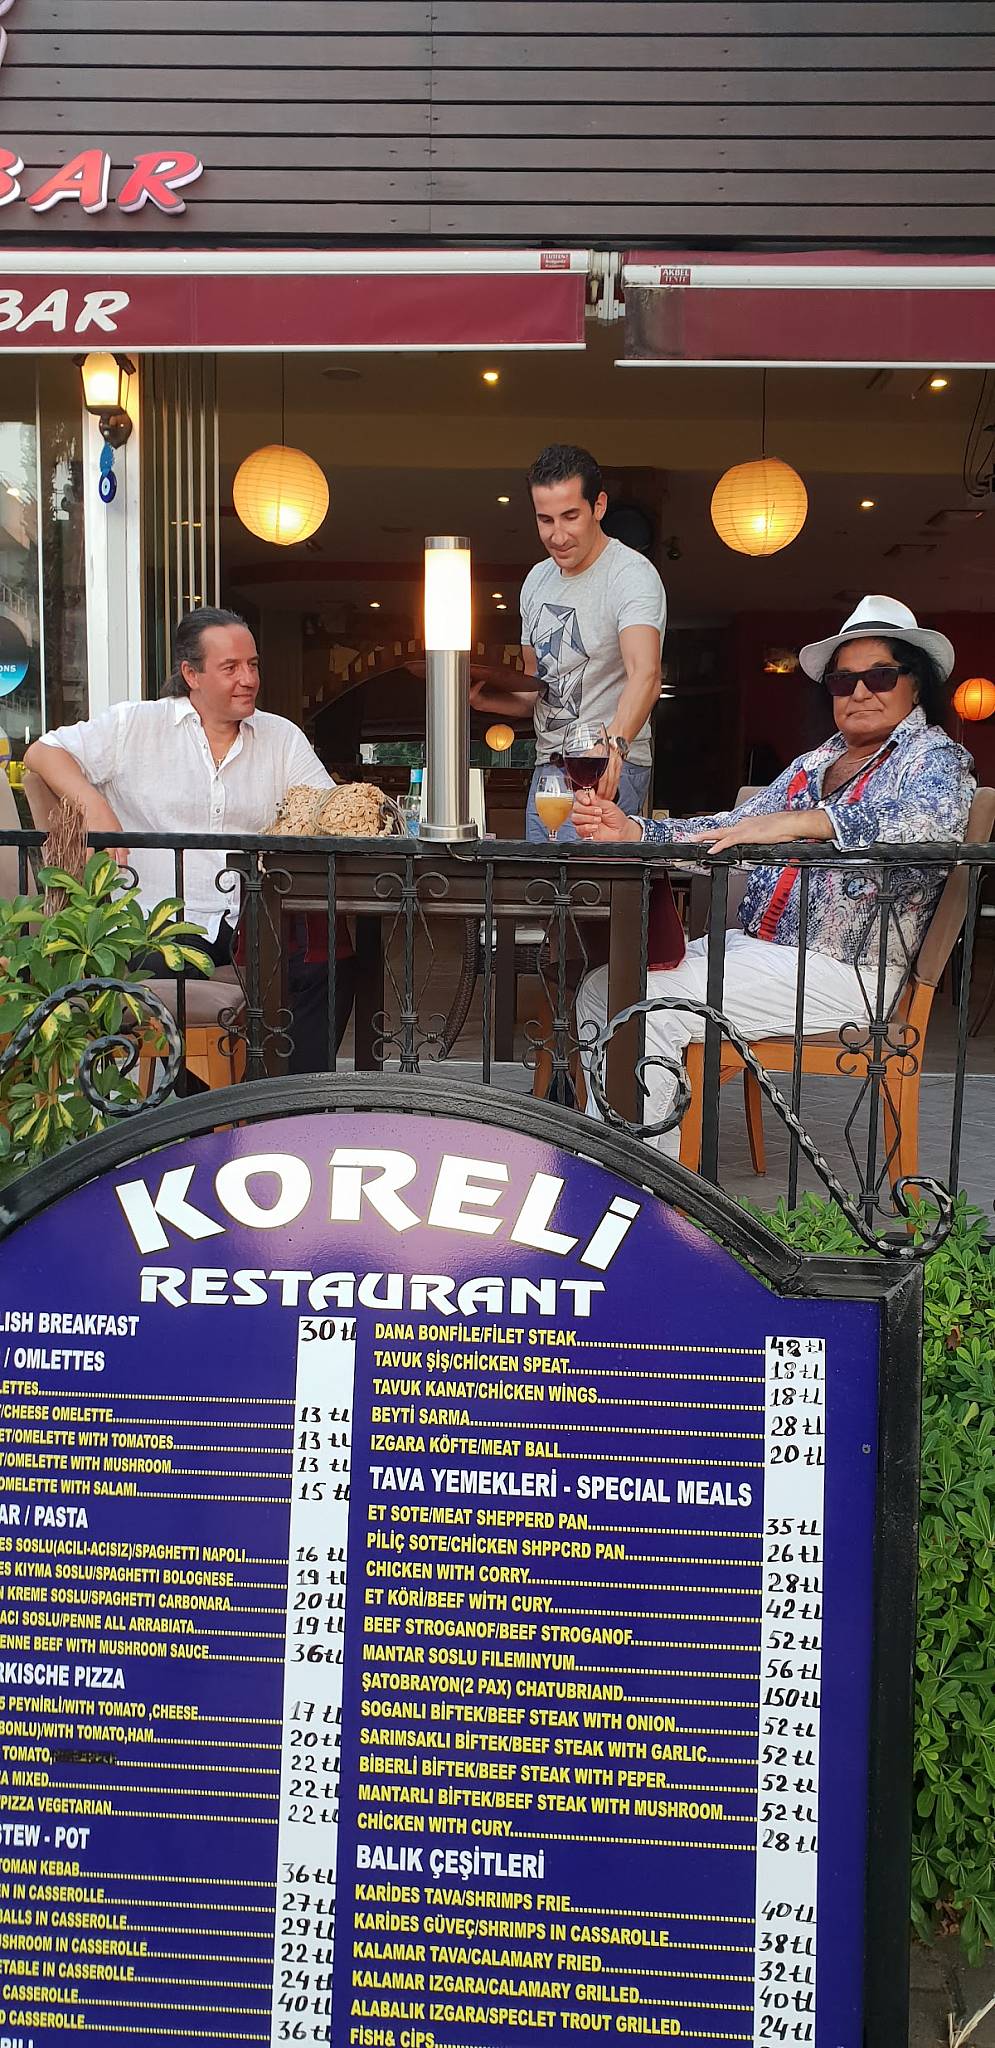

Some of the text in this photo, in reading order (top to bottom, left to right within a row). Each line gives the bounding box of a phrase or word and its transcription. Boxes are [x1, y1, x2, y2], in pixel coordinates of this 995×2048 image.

[139, 1266, 606, 1316] RESTAURANT
[38, 1312, 140, 1336] BREAKFAST
[375, 1323, 415, 1340] DANA
[528, 1328, 577, 1347] STEAK
[13, 1347, 105, 1372] OMLETTES
[373, 1350, 423, 1368] TAVUK
[523, 1356, 569, 1374] SPEAT
[372, 1378, 422, 1396] TAVUK
[51, 1406, 114, 1423] OMELETTE
[418, 1408, 470, 1426] SARMA
[78, 1431, 174, 1450] WITH TOMATOES
[370, 1434, 426, 1452] IZGARA
[525, 1440, 563, 1458] BALL
[70, 1455, 172, 1474] WITH MUSHROOM
[60, 1479, 137, 1497] WITH SALAMI
[369, 1466, 425, 1492] TAVA
[576, 1475, 671, 1503] SPECIAL
[677, 1480, 752, 1507] MEALS
[34, 1505, 88, 1529] PASTA
[368, 1504, 387, 1521] ET
[476, 1509, 555, 1529] SHEPPERD
[558, 1513, 588, 1530] PAN
[202, 1546, 246, 1563] NAPOLI
[595, 1543, 625, 1560] PAN
[14, 1561, 53, 1578] KIYMA
[163, 1569, 234, 1587] BOLOGNESE
[366, 1560, 529, 1584] CHICKEN WITH CORRY
[7, 1585, 48, 1602] KREME
[158, 1593, 231, 1612] CARBONARA
[365, 1588, 384, 1605] ET
[511, 1595, 552, 1613] CURY
[104, 1615, 126, 1631] ALL
[128, 1616, 195, 1634] ARRABIATA
[364, 1616, 402, 1634] BEEF
[540, 1625, 633, 1645] STROGANOF
[33, 1636, 209, 1660] BEEF WITH MUSHROOM SAUCE
[363, 1644, 575, 1671] MANTAR SOSLU FILEMINYUM
[74, 1665, 125, 1690] PIZZA
[477, 1678, 512, 1700] PAX)
[515, 1680, 624, 1701] CHATUBRIAND
[97, 1701, 146, 1718] TOMATO
[361, 1699, 426, 1719] SOGANLI
[529, 1709, 580, 1727] STEAK
[582, 1711, 622, 1730] WITH
[626, 1714, 675, 1733] ONION
[360, 1727, 451, 1749] SARIMSAKLI
[554, 1738, 604, 1757] STEAK
[607, 1741, 647, 1759] WITH
[651, 1743, 707, 1763] GARLIC
[12, 1770, 49, 1787] MIXED
[520, 1764, 571, 1784] STEAK
[574, 1767, 613, 1786] WITH
[617, 1770, 668, 1789] PEPER
[37, 1796, 112, 1816] VEGETARIAN
[358, 1784, 434, 1804] MANTARLI
[537, 1794, 587, 1813] STEAK
[590, 1797, 630, 1815] WITH
[634, 1799, 723, 1821] MUSHROOM
[54, 1826, 90, 1850] POT
[428, 1816, 467, 1835] WITH
[471, 1818, 512, 1837] CURY
[40, 1860, 80, 1877] KEBAB
[356, 1844, 424, 1872] BALIK
[13, 1883, 105, 1904] IN CASSEROLLE
[537, 1894, 571, 1912] FRIE
[35, 1910, 127, 1930] IN CASSEROLLE
[55, 1936, 148, 1957] IN CASSEROLLE
[550, 1924, 566, 1941] IN
[570, 1925, 669, 1947] CASSAROLLE
[353, 1941, 426, 1962] KALAMAR
[557, 1953, 602, 1972] FRIED
[42, 1961, 135, 1982] IN CASSEROLLE
[2, 1984, 79, 2004] CASSEROLLE
[352, 1969, 425, 1991] KALAMAR
[575, 1983, 640, 2004] GRILLED
[9, 2010, 85, 2030] CASSEROLLE
[350, 1999, 425, 2020] ALABALIK
[560, 2011, 612, 2031] TROUT
[615, 2015, 681, 2036] GRILLED
